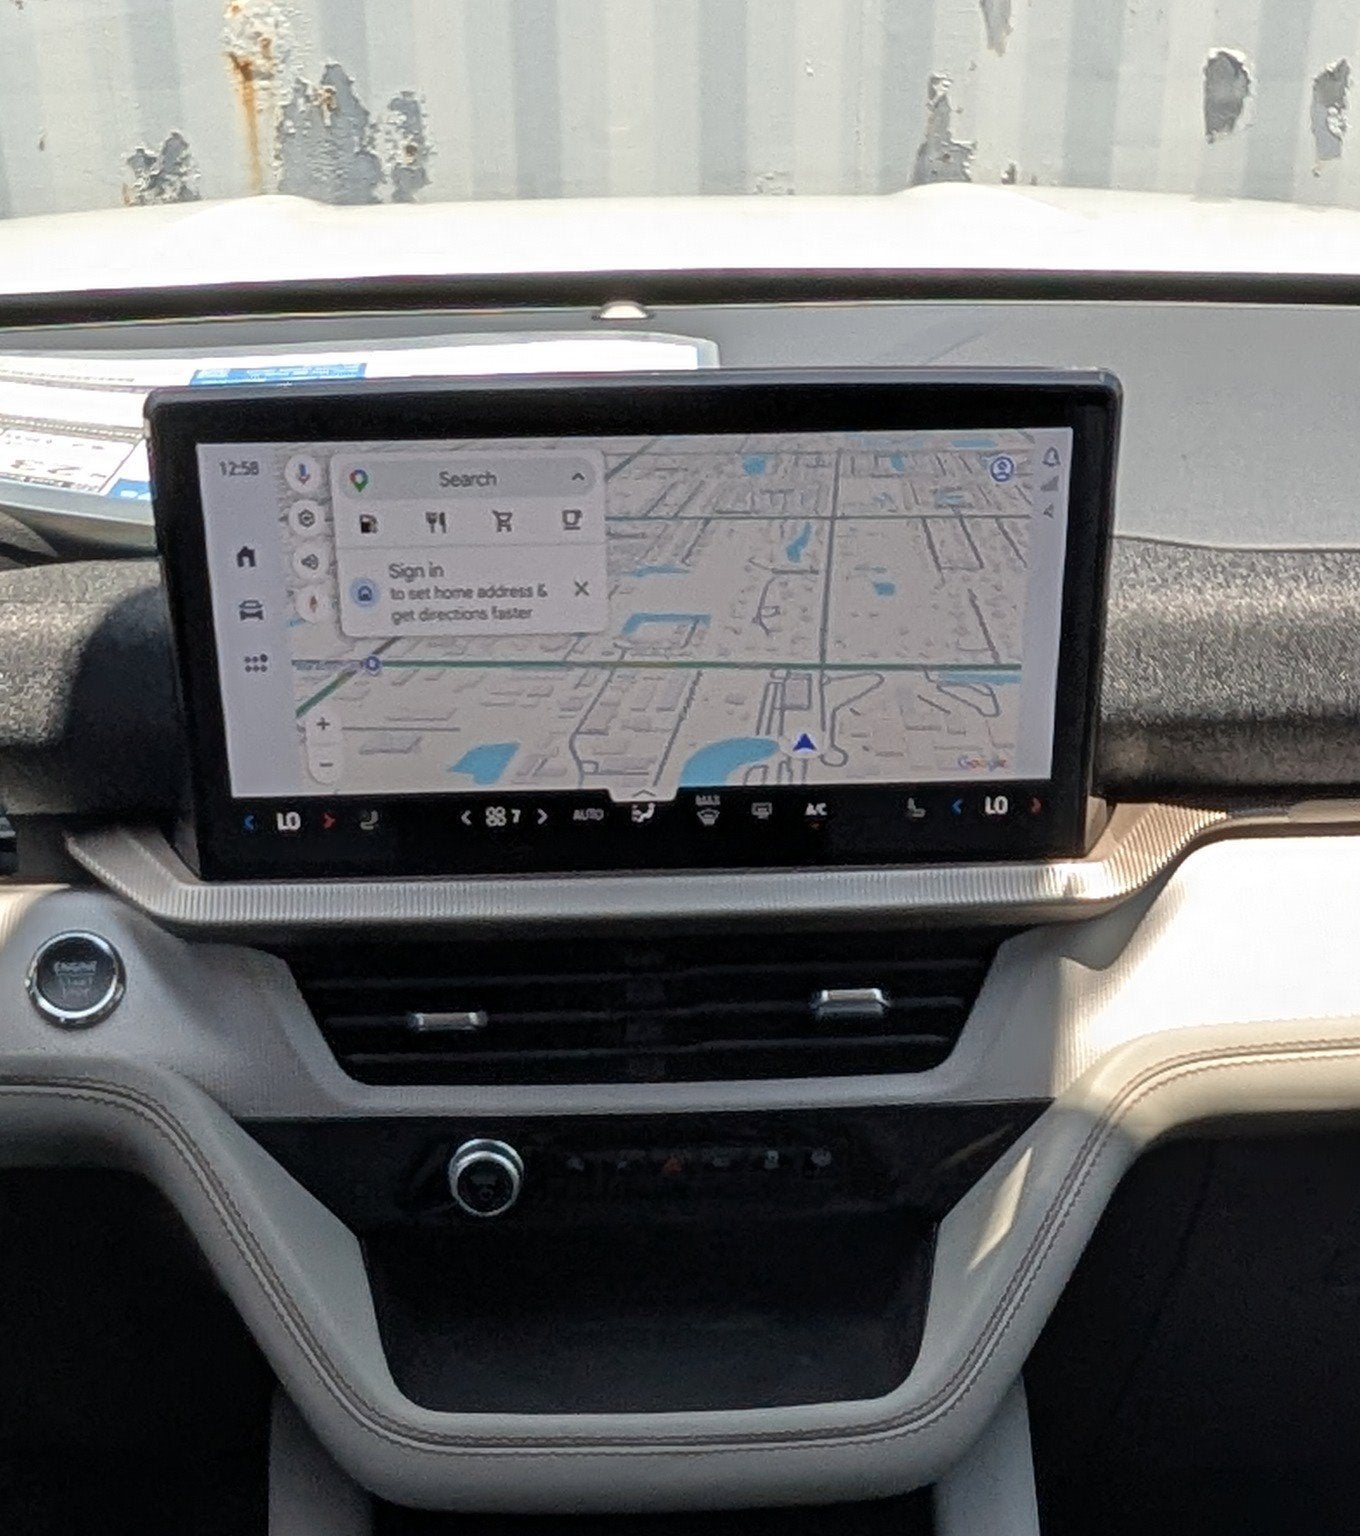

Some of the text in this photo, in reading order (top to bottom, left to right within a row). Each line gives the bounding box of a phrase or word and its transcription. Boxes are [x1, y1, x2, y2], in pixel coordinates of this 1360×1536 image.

[219, 460, 260, 476] 12:58
[439, 471, 498, 489] Search
[388, 562, 445, 583] Sign in
[390, 583, 548, 600] to set home address &
[391, 605, 533, 625] get directions faster
[572, 807, 605, 822] AUTO
[805, 802, 828, 817] A/C
[984, 796, 1009, 816] LO
[276, 811, 302, 831] LO
[511, 808, 521, 824] 7
